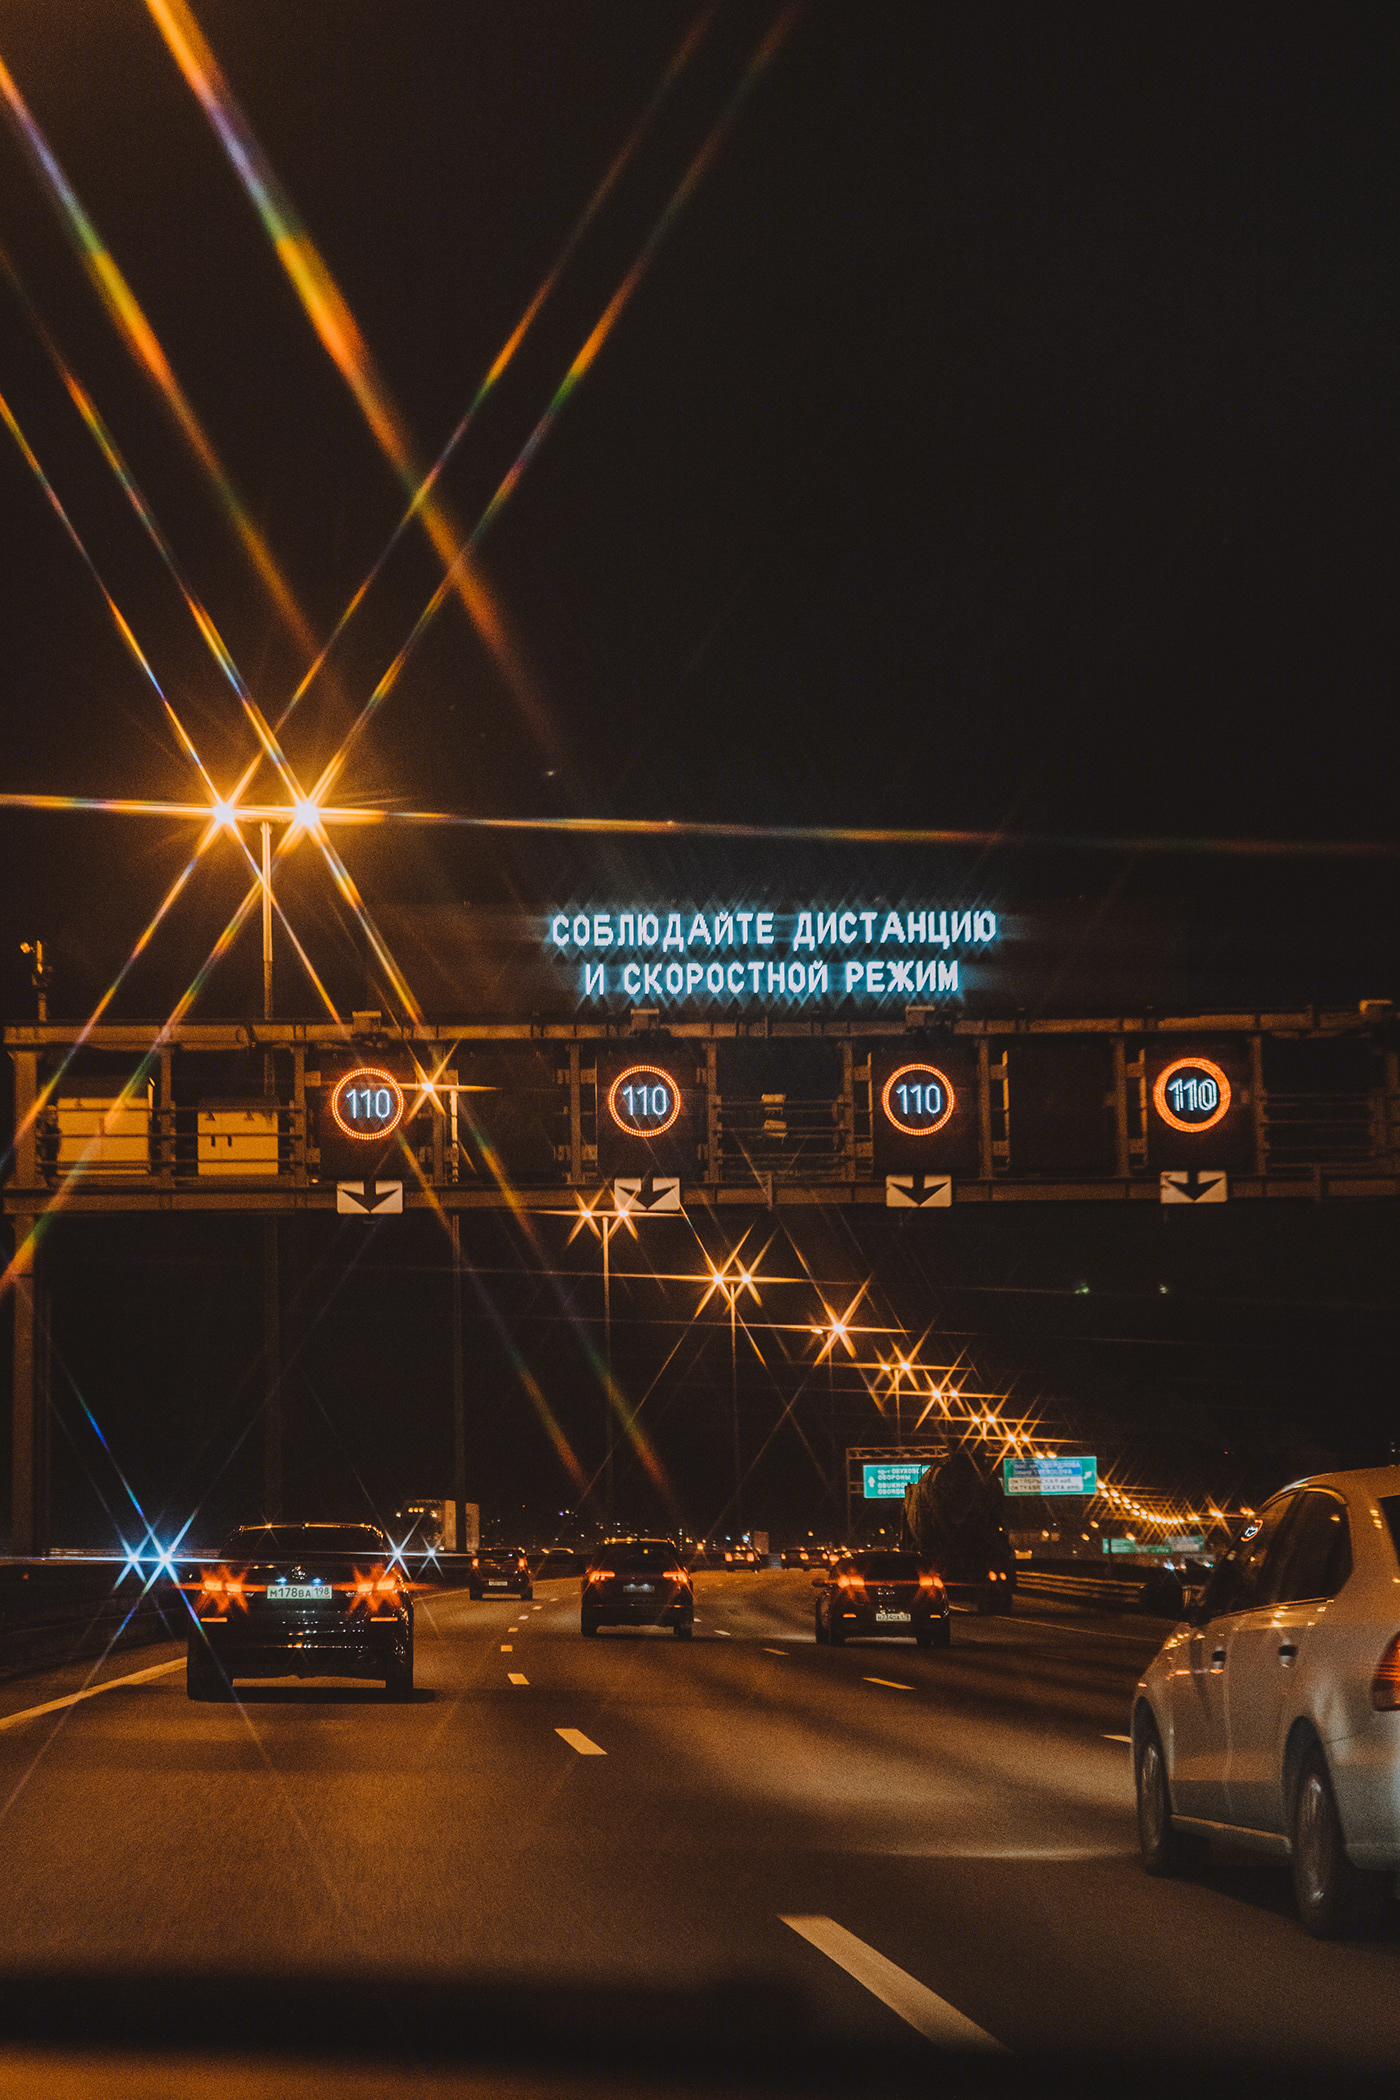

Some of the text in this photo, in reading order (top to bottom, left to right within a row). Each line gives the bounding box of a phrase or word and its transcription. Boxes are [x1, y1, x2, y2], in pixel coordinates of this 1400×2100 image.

[552, 911, 997, 952] СОБЛЮДАЙТЕ ДИСТАНЦИЮ
[585, 960, 959, 995] И СКОРОСТНОЙ РЕЖИМ
[346, 1087, 391, 1120] 110
[622, 1085, 668, 1117] 110
[896, 1084, 942, 1115] 110
[1167, 1078, 1218, 1112] 110
[270, 1587, 329, 1597] М178ВА 198
